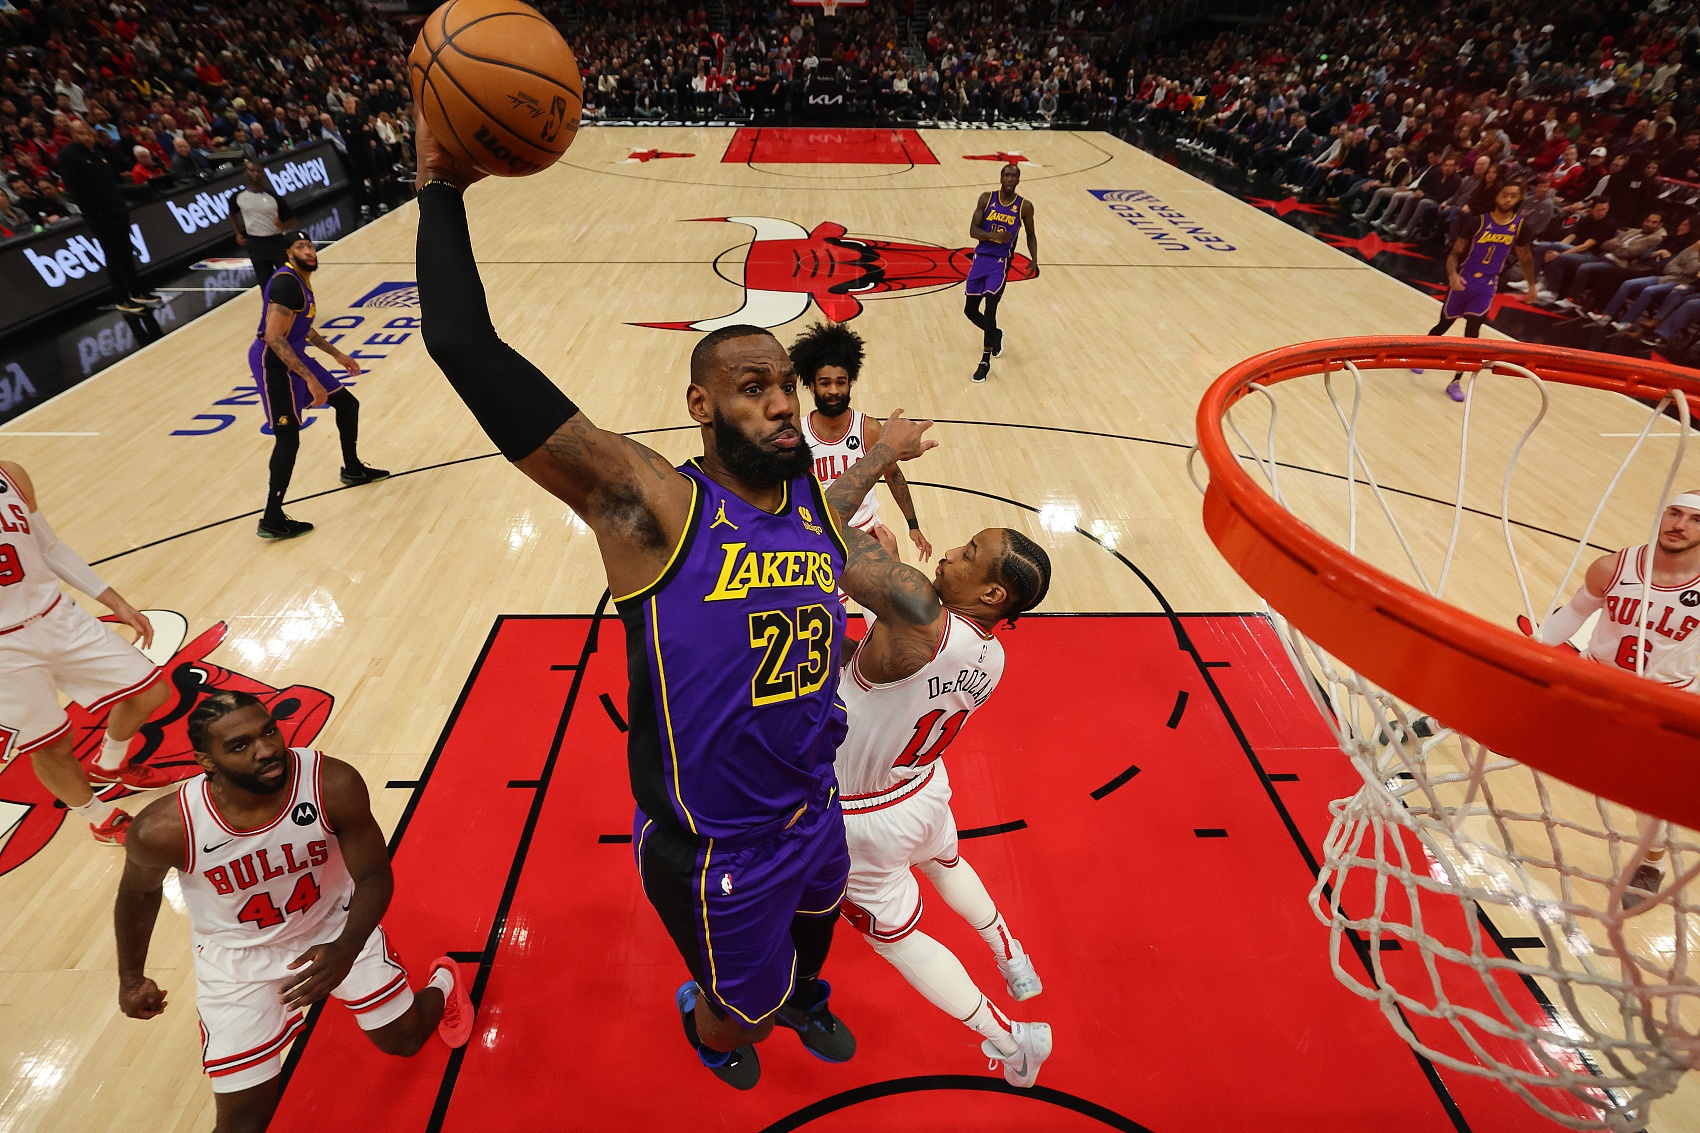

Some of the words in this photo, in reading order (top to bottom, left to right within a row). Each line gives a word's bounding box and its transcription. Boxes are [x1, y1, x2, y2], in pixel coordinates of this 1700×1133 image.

[264, 156, 331, 198] betway
[166, 184, 246, 234] betw
[985, 209, 1017, 226] LAKERS
[1108, 204, 1191, 251] UNITED
[1148, 205, 1238, 252] CENTER
[22, 222, 151, 288] betwy
[1481, 245, 1497, 265] 1
[168, 314, 365, 437] UNED
[259, 316, 421, 436] CNTER
[809, 454, 863, 483] ULL
[703, 541, 836, 603] LAKERS
[748, 603, 834, 708] 23
[1614, 634, 1654, 673] 6
[891, 709, 971, 768] 11
[203, 839, 329, 896] BULLS
[236, 871, 321, 930] 44
